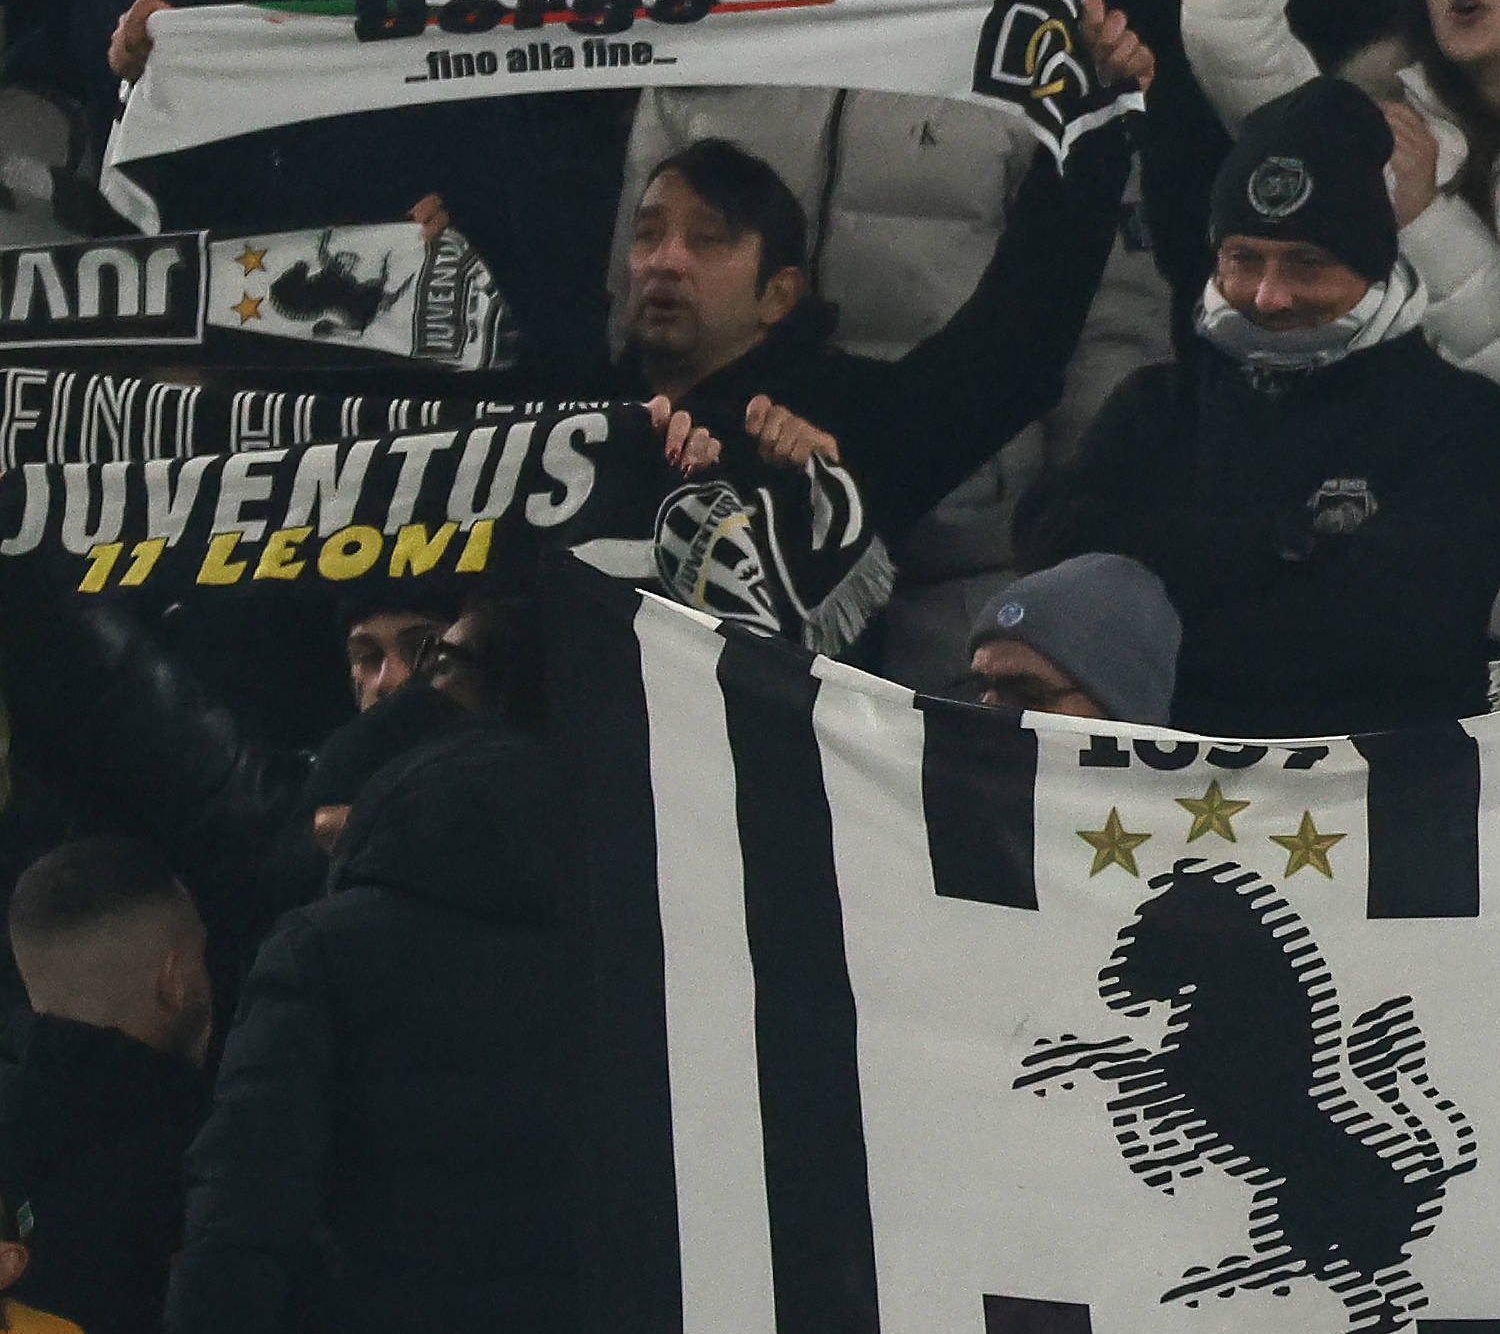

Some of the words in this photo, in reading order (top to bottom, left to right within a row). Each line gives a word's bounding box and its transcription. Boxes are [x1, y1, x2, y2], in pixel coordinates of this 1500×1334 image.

[505, 41, 574, 74] alla
[8, 245, 180, 323] JUV
[0, 413, 610, 557] JUVENTUS
[195, 518, 498, 586] LEONI
